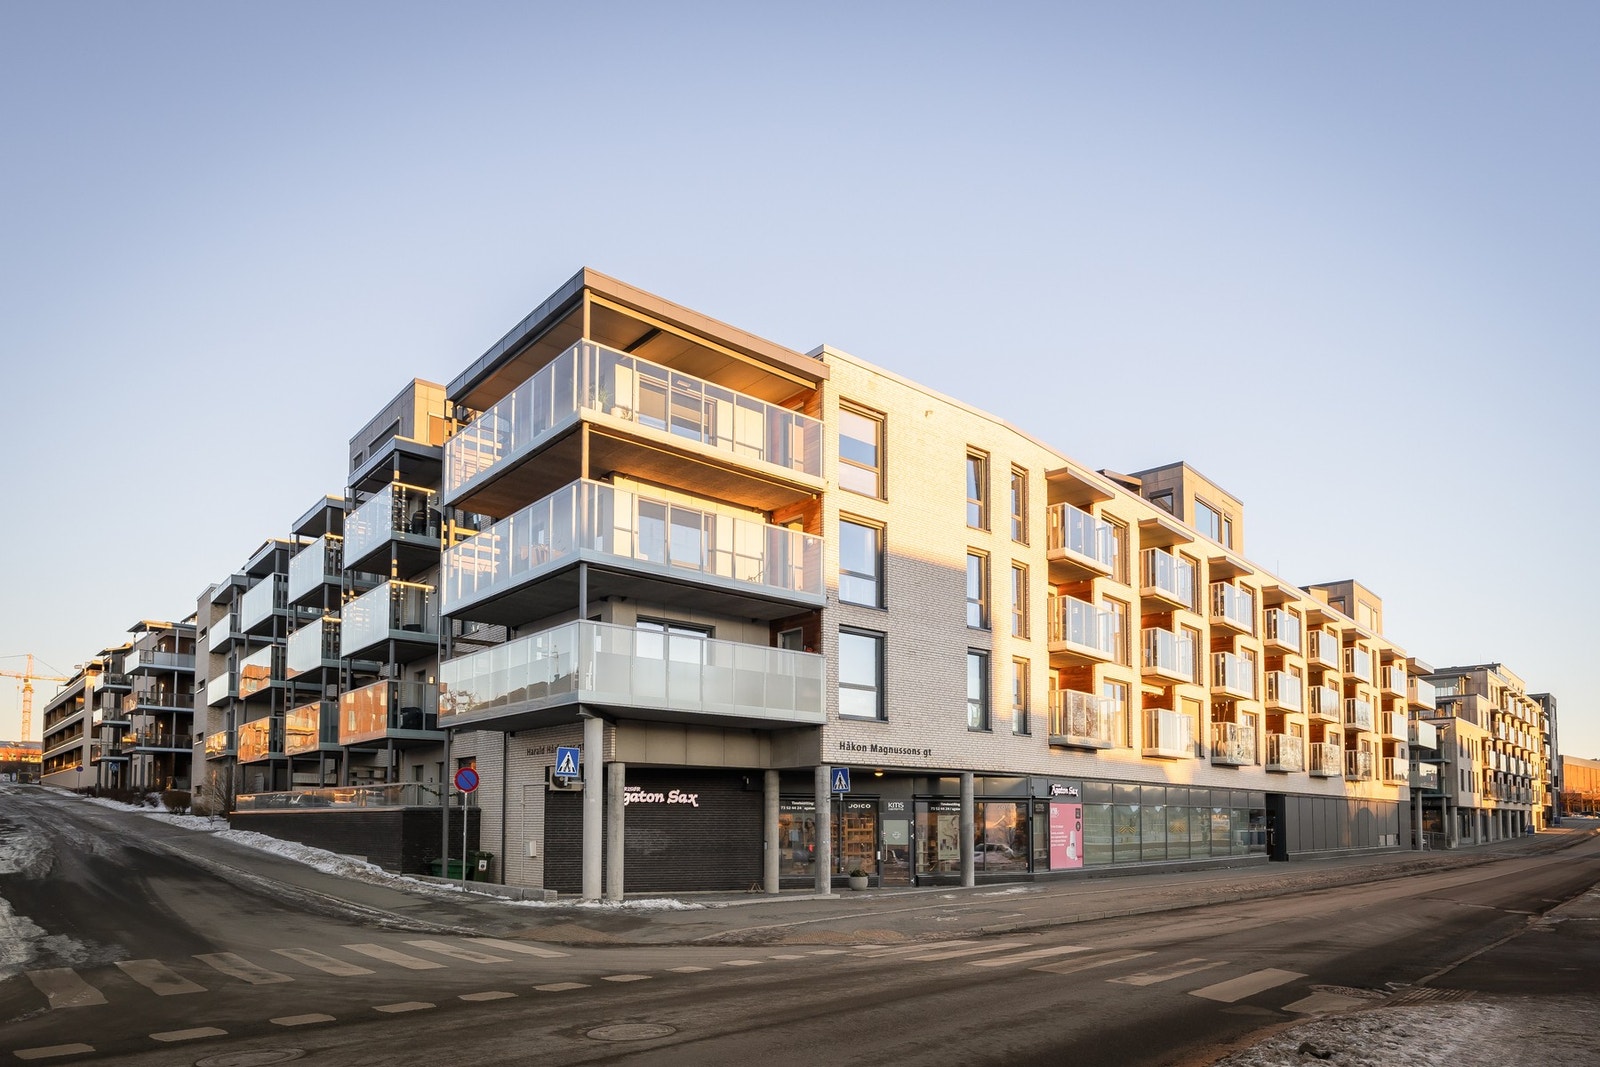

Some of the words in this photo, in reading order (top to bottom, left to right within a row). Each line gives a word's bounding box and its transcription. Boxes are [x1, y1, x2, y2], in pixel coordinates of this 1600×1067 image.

[840, 741, 867, 752] Håkon
[870, 744, 921, 755] Magnussons
[923, 748, 932, 758] gt
[624, 790, 665, 806] gaton
[667, 789, 699, 807] Sax
